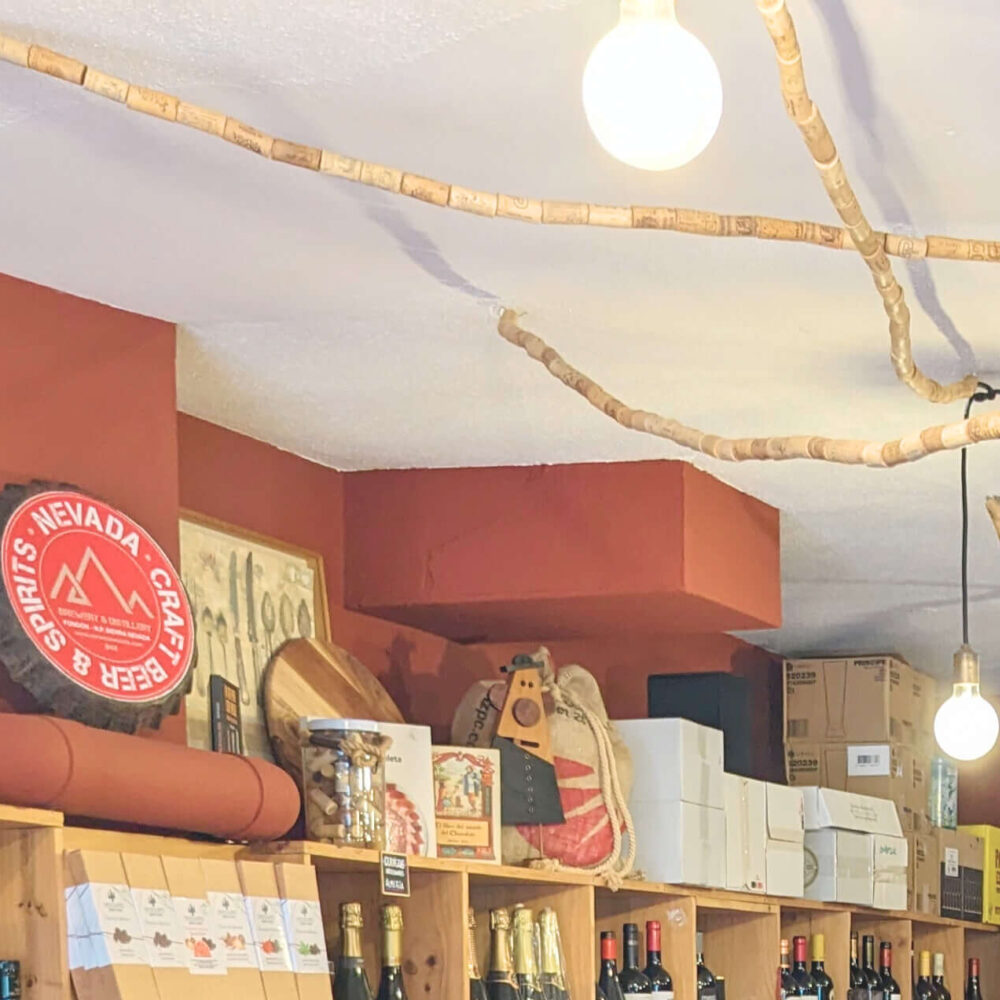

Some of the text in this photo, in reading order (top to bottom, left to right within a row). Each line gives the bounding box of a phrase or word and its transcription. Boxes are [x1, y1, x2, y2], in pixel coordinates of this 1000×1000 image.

[31, 501, 141, 558] NEVADA
[12, 537, 67, 653] SPIRITS
[150, 568, 185, 667] CRAFT
[71, 647, 93, 677] &
[99, 656, 169, 692] BEER
